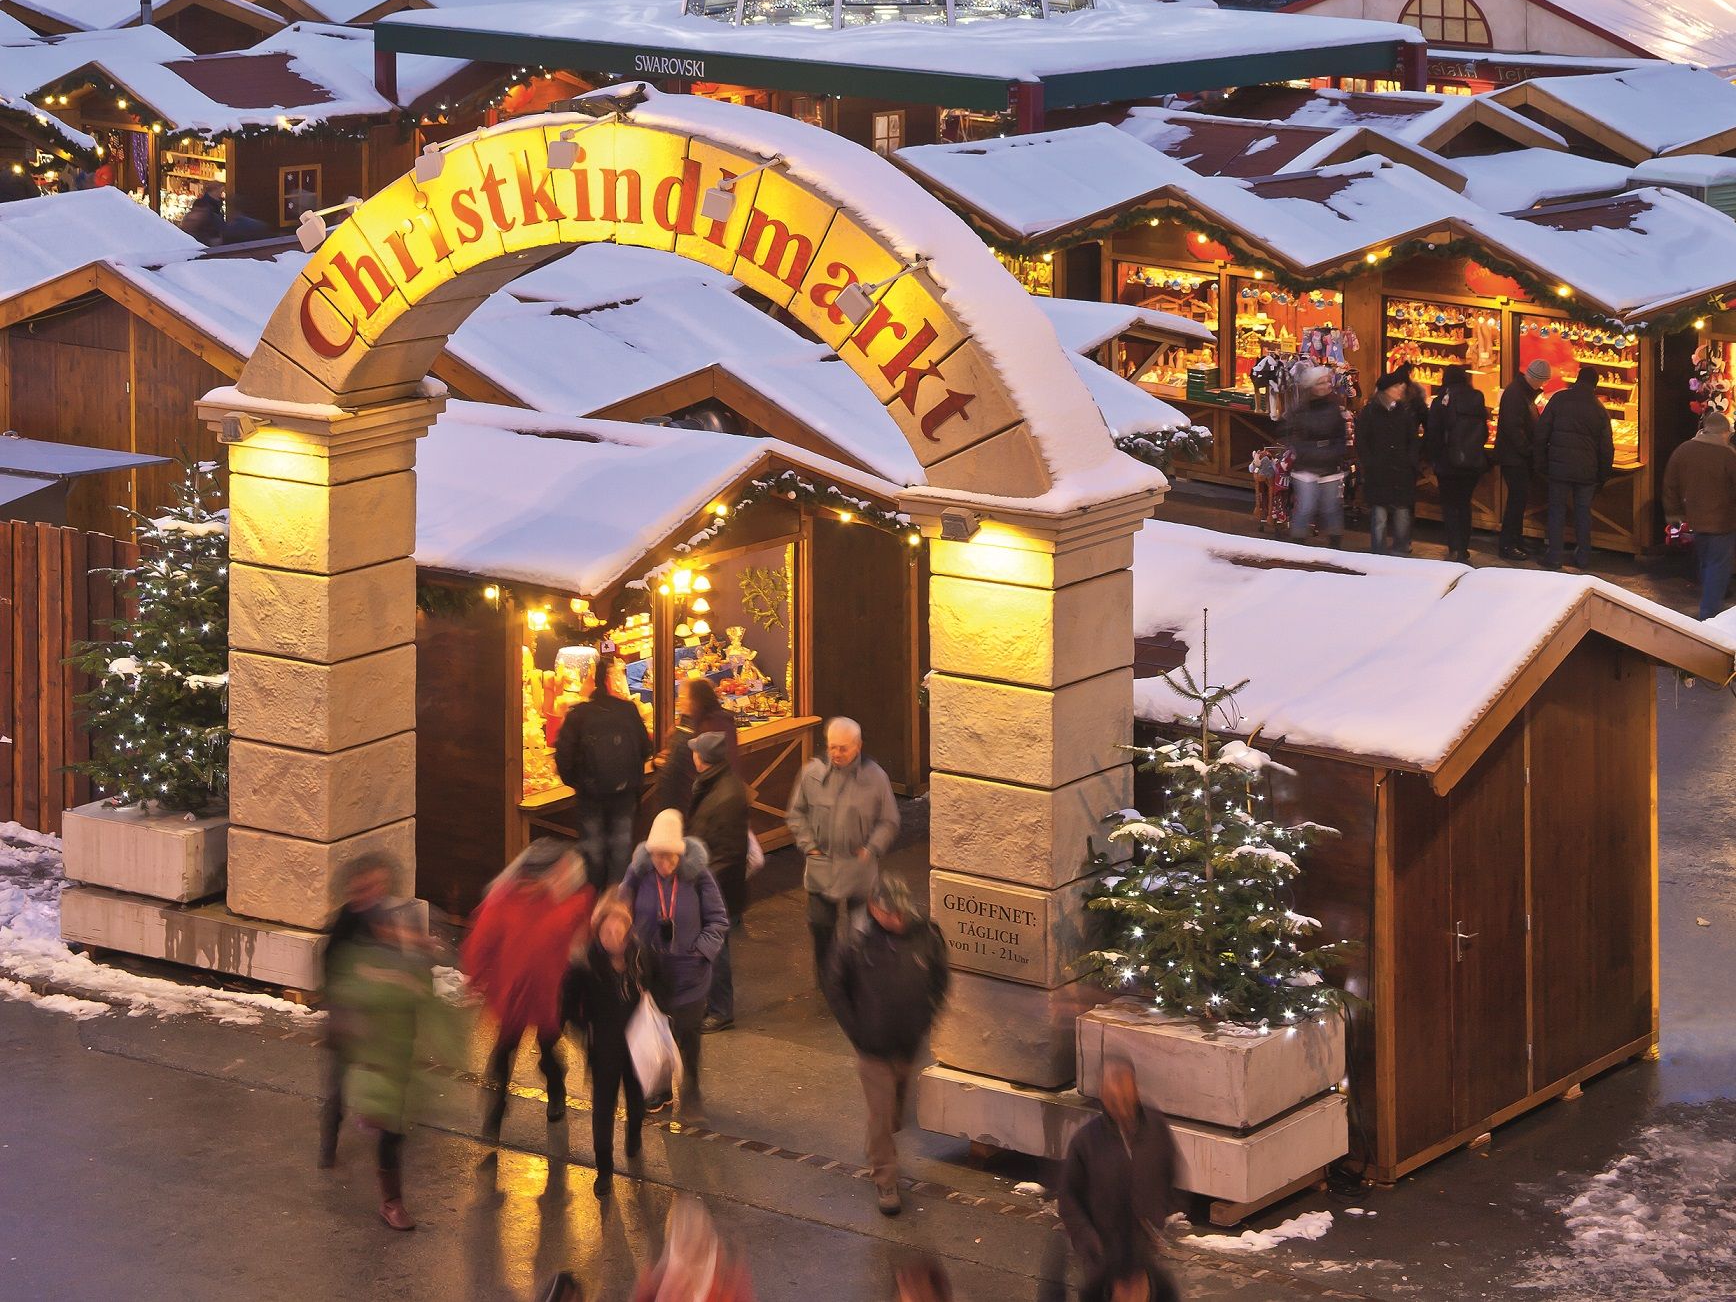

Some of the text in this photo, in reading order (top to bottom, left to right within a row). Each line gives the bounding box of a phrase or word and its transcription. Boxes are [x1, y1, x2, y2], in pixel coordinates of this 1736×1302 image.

[635, 55, 705, 78] SWAROVSKI
[299, 149, 977, 443] Christkindlmarkt
[943, 893, 1037, 927] GEÖFFNET:
[957, 920, 1020, 946] TÄGLICH
[948, 940, 970, 952] von
[975, 942, 986, 955] 11
